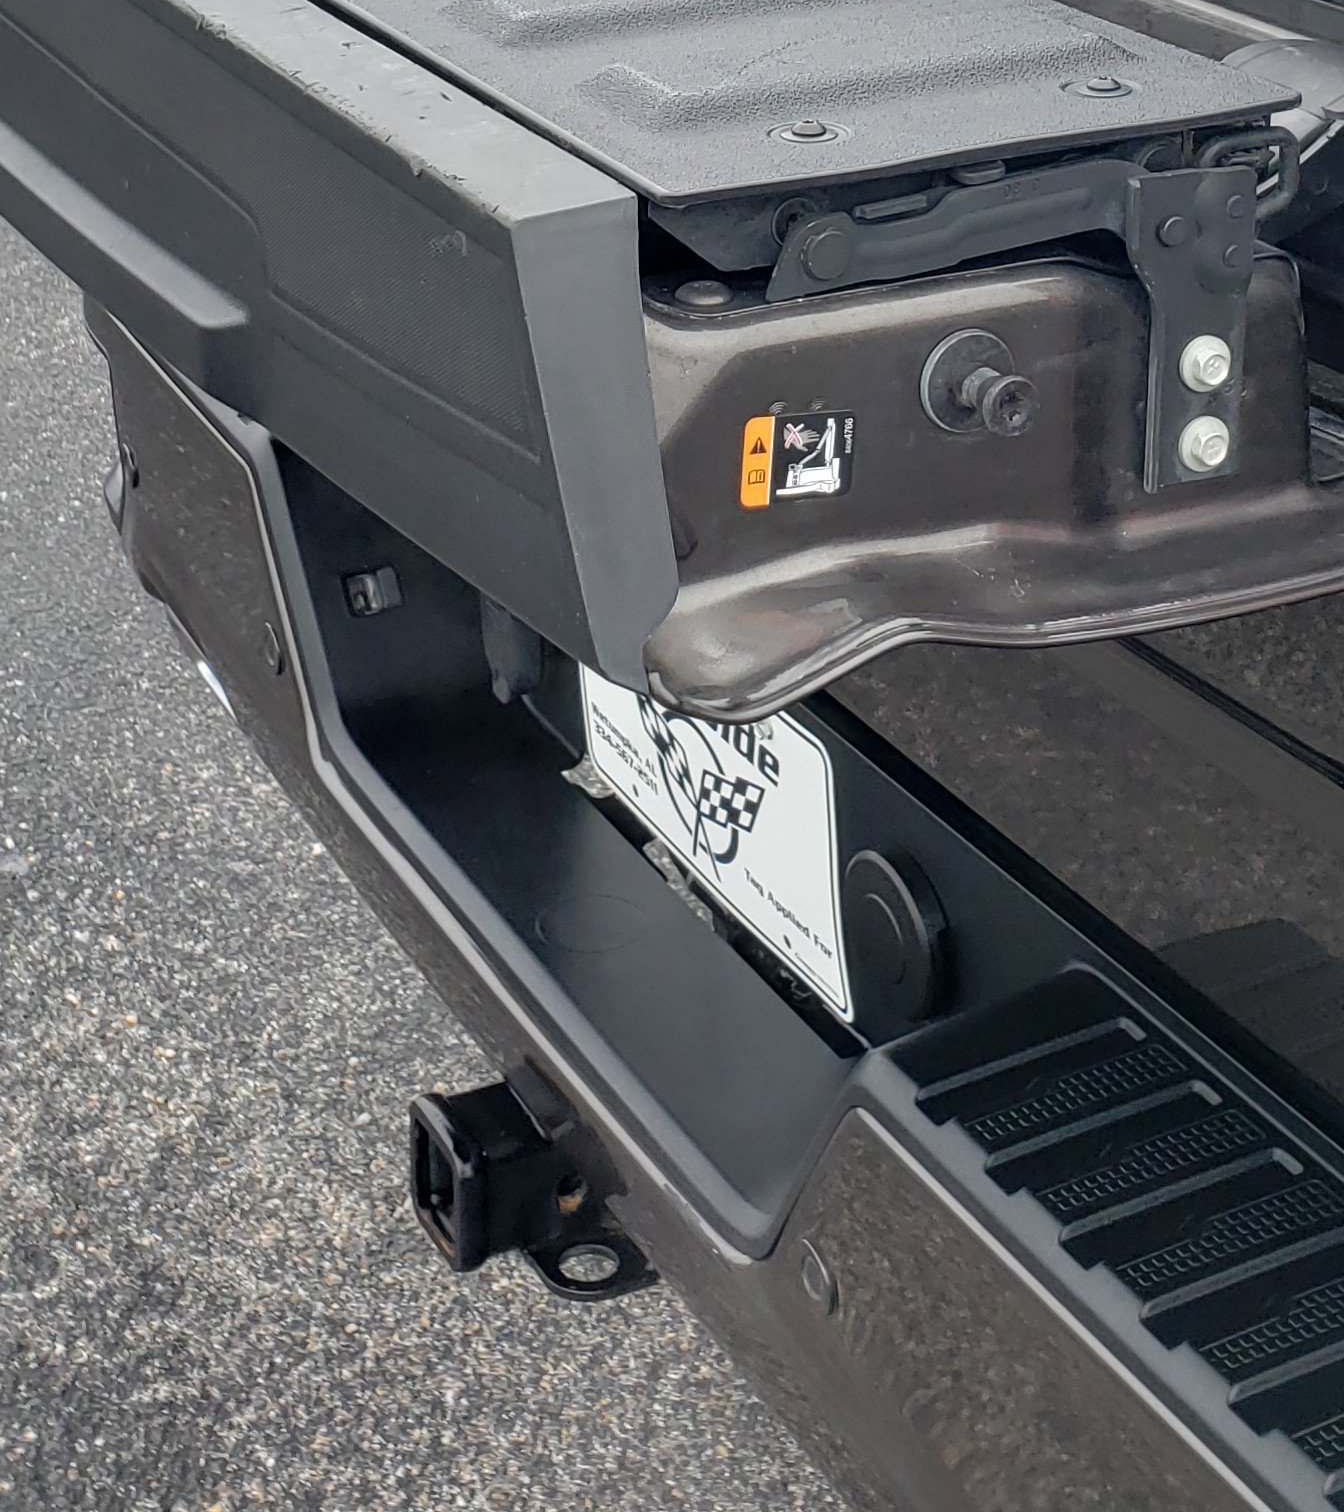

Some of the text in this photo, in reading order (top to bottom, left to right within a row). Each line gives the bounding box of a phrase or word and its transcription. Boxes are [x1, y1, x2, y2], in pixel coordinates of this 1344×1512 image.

[644, 756, 658, 779] AL
[743, 867, 833, 960] Tag Applied For
